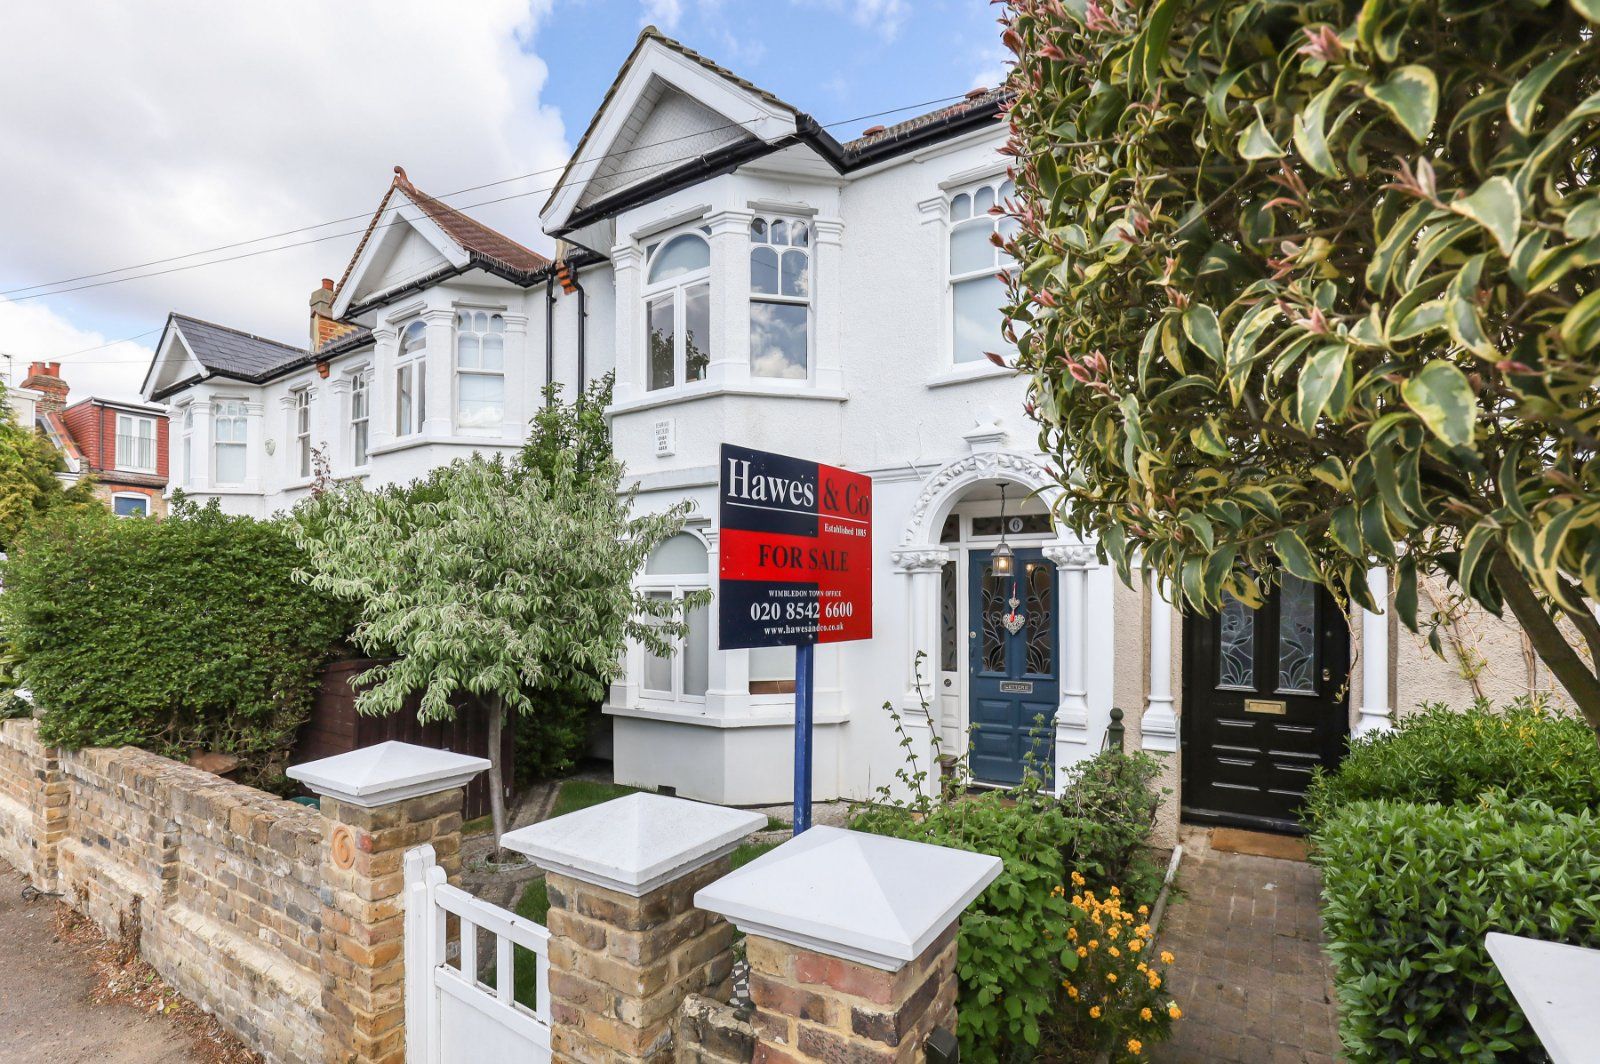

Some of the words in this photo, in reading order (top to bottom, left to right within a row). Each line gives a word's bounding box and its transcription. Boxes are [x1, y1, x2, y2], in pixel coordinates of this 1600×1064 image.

[727, 458, 814, 507] Hawes
[823, 477, 840, 511] &
[845, 482, 869, 516] Co
[824, 523, 854, 536] Established
[759, 544, 803, 569] FOR
[808, 548, 849, 572] SALE
[768, 590, 807, 598] WIMBLEDON
[808, 590, 824, 598] TOWN
[825, 590, 842, 598] OFFICE
[750, 602, 781, 621] 020
[786, 601, 820, 620] 8542
[825, 601, 853, 618] 6600
[764, 622, 844, 635] www.hawesandco.co.uk
